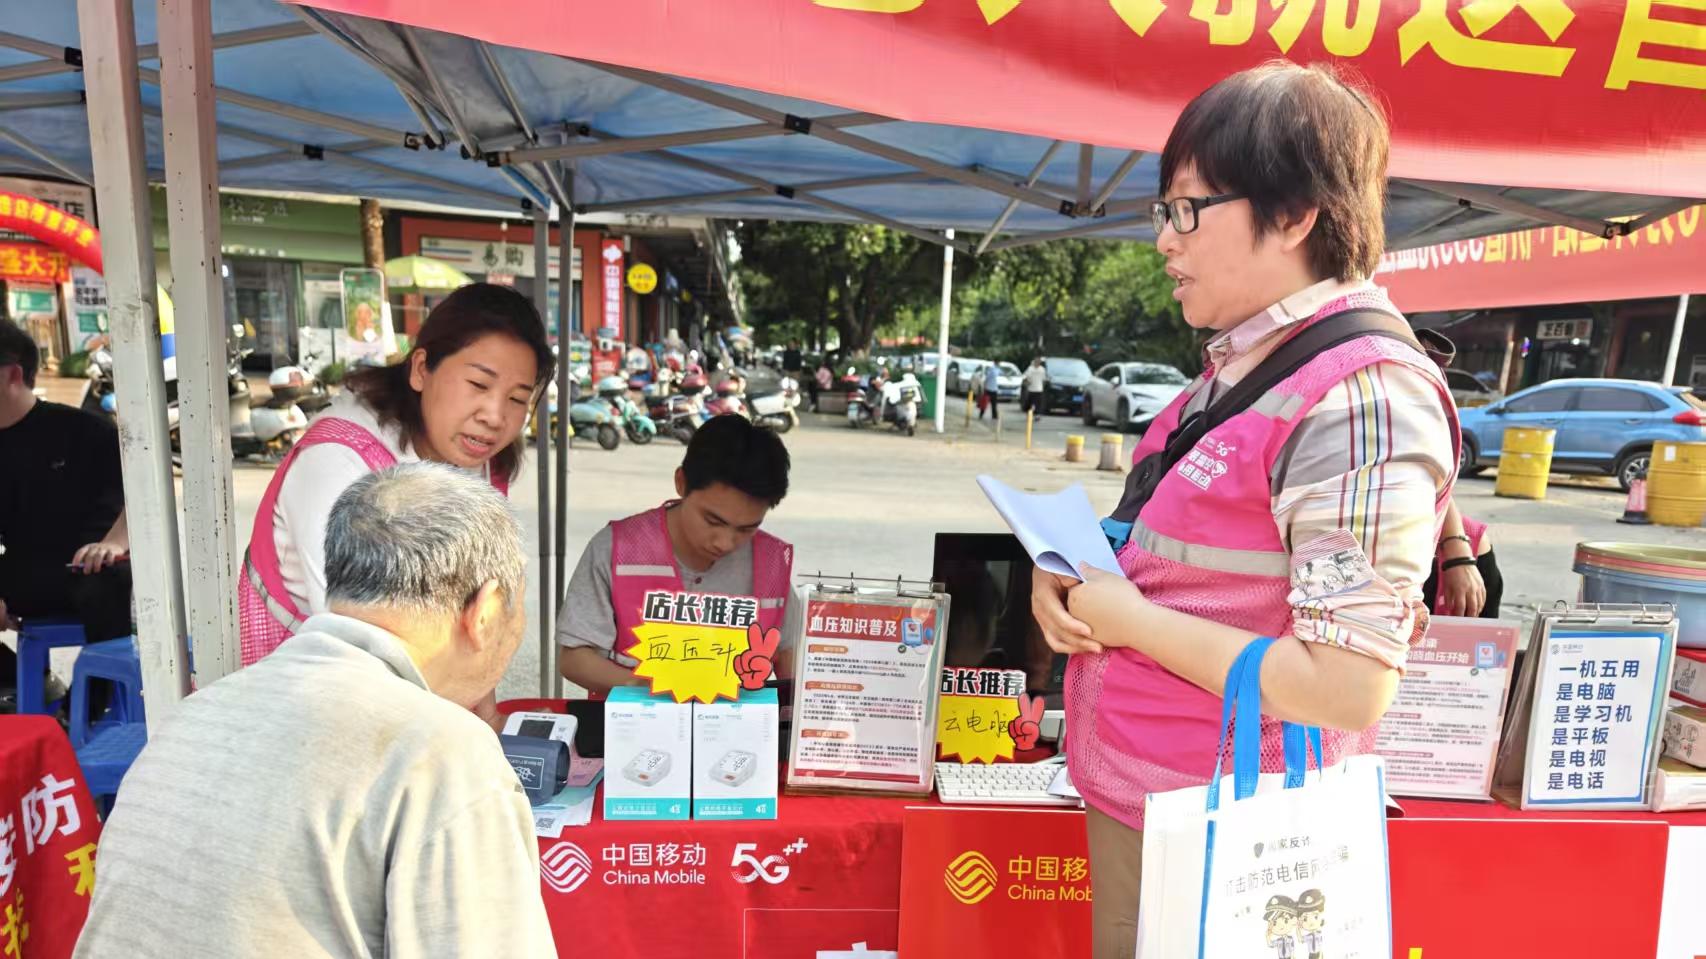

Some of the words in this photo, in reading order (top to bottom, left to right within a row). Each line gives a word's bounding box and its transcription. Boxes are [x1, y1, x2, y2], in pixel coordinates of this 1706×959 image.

[644, 592, 757, 627] 店长推荐
[809, 614, 897, 637] 血压知识普及
[1559, 659, 1640, 679] 一机五用
[941, 669, 1024, 696] 店长推荐
[1555, 682, 1617, 701] 是电脑
[1553, 704, 1633, 723] 是学习机
[1551, 726, 1610, 746] 是平板
[1548, 748, 1607, 768] 是电视
[1547, 771, 1605, 790] 是电话
[602, 842, 706, 867] 中国移动
[603, 869, 650, 885] China
[654, 869, 706, 885] Mobile
[1007, 884, 1055, 901] China
